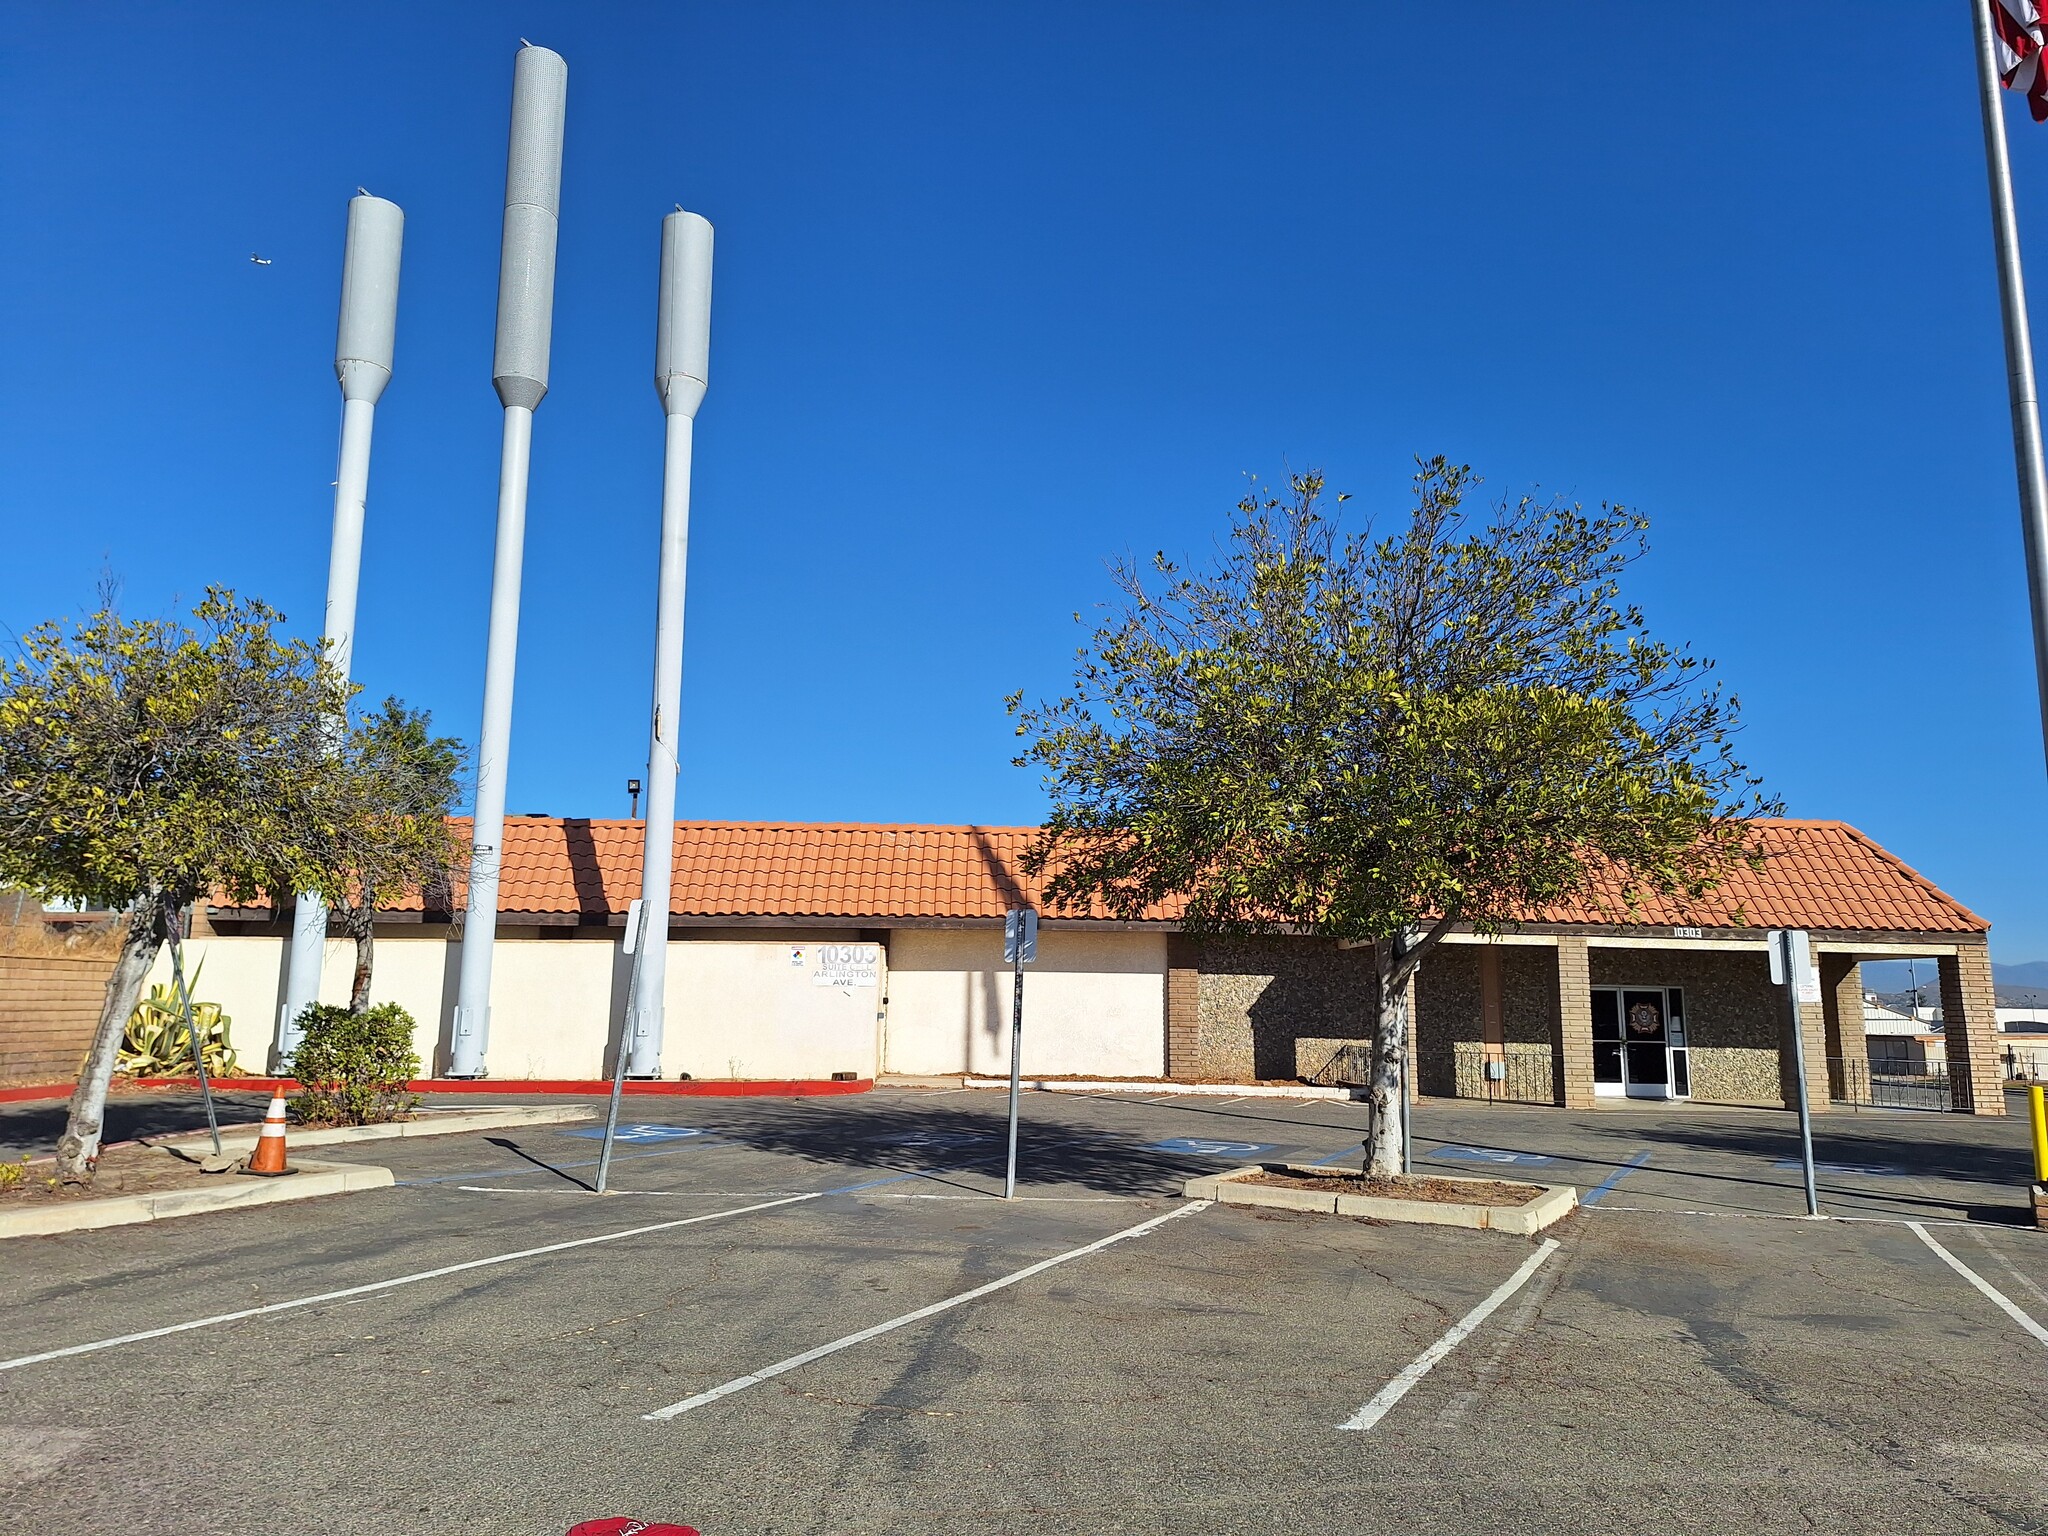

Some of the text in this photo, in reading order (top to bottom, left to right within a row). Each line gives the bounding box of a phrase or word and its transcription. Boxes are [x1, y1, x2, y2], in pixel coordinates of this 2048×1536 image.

[1674, 927, 1702, 938] 10303
[818, 945, 876, 964] 10303
[822, 963, 872, 971] SUITE CL
[813, 970, 877, 978] ARLINGTON
